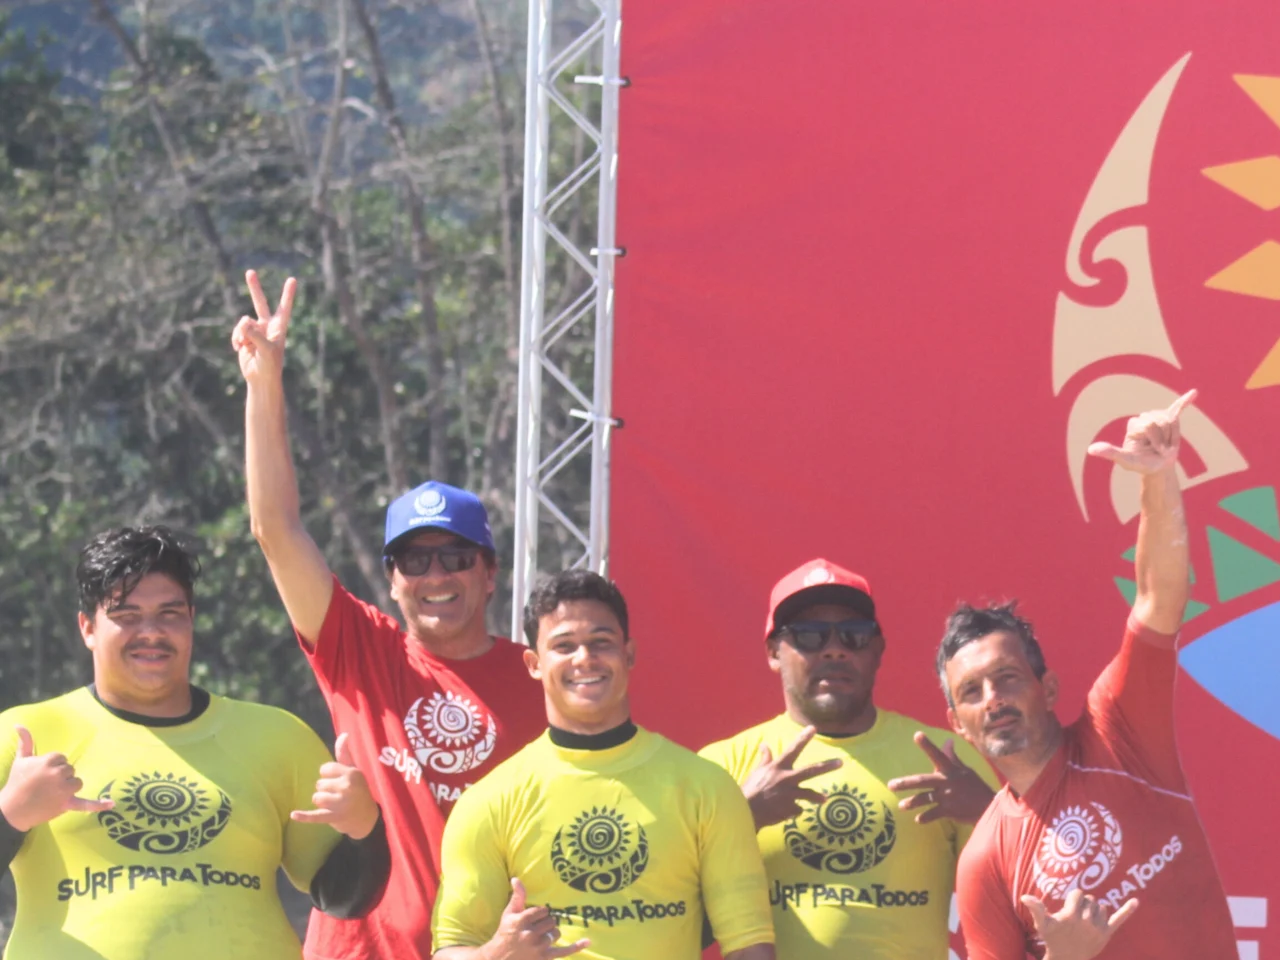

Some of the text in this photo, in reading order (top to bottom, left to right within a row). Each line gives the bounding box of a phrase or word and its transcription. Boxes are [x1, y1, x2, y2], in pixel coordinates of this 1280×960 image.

[1126, 835, 1183, 889] TODOS
[57, 863, 261, 902] SURF PARA TODOS
[769, 879, 929, 911] URF PARA TODOS
[581, 905, 636, 928] PARA
[630, 899, 686, 923] TODOS
